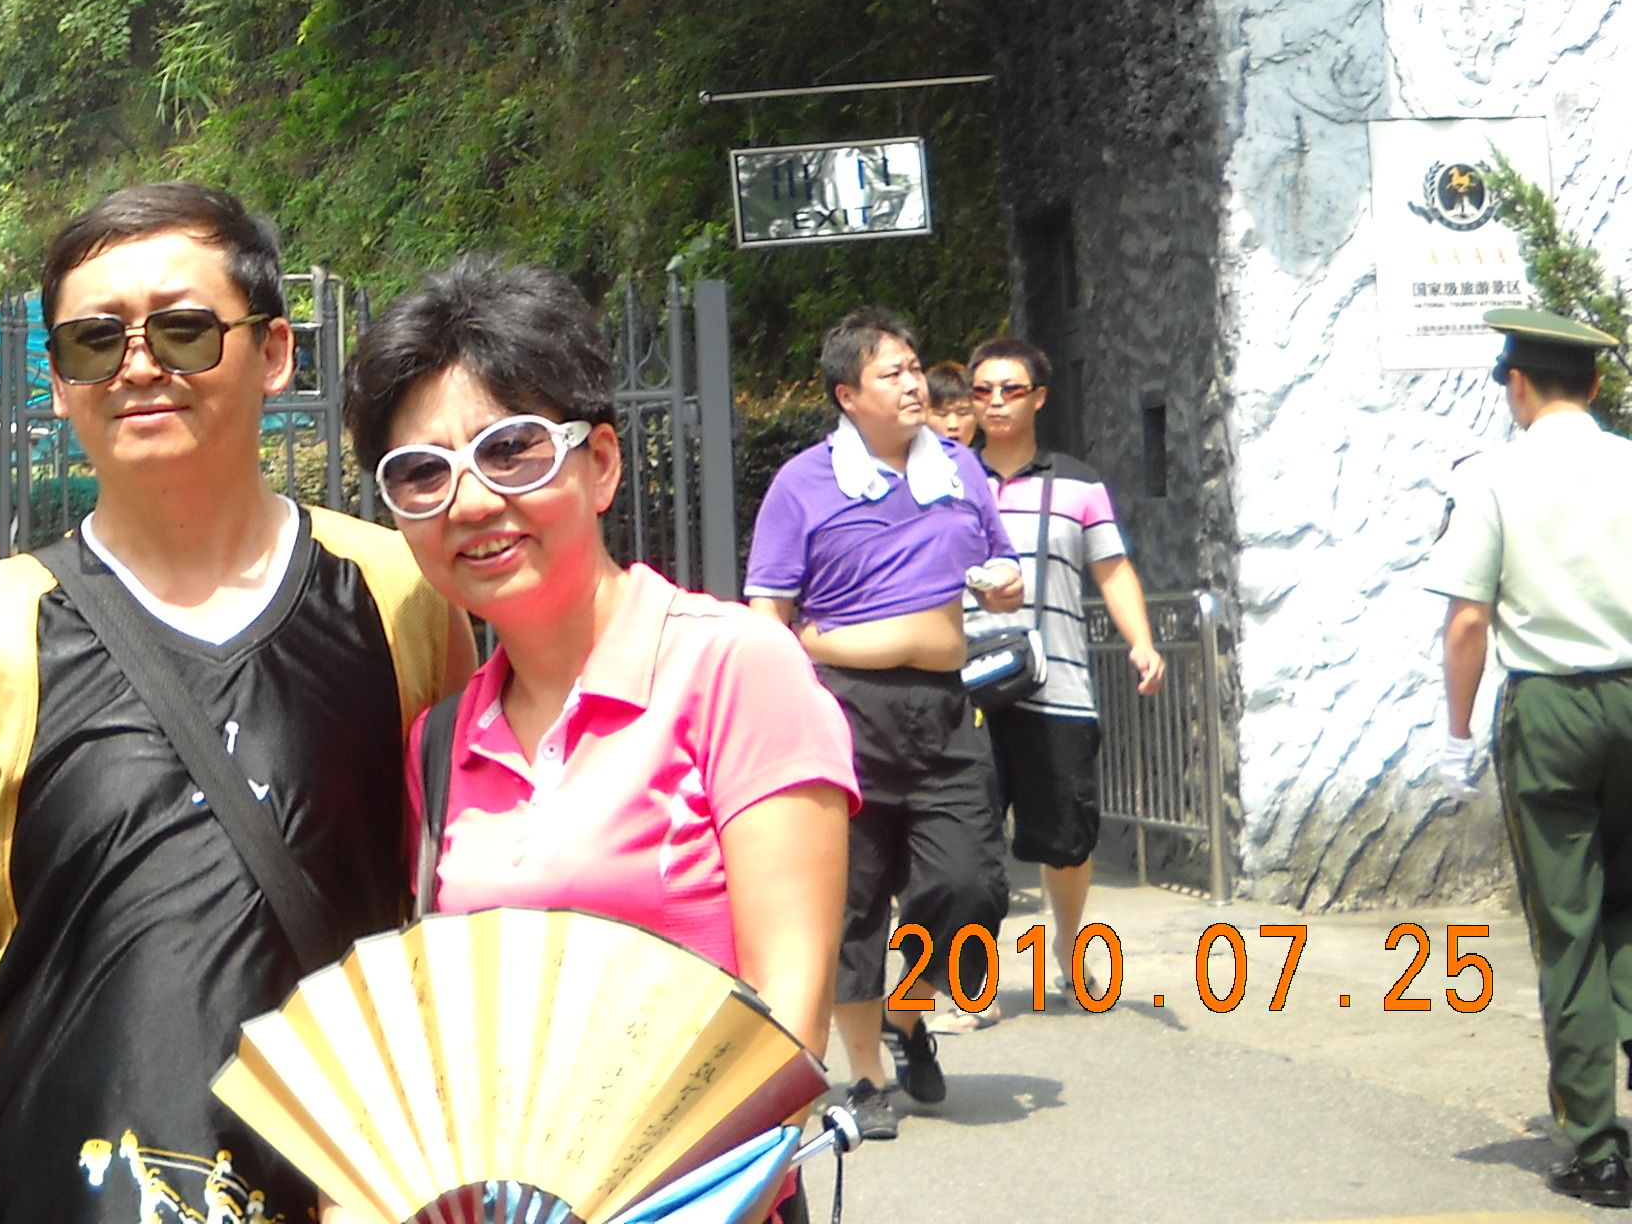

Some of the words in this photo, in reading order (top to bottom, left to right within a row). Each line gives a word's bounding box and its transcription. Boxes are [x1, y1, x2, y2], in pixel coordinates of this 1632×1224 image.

[792, 206, 873, 229] EXIT
[1412, 280, 1522, 296] 国家级旅游景区
